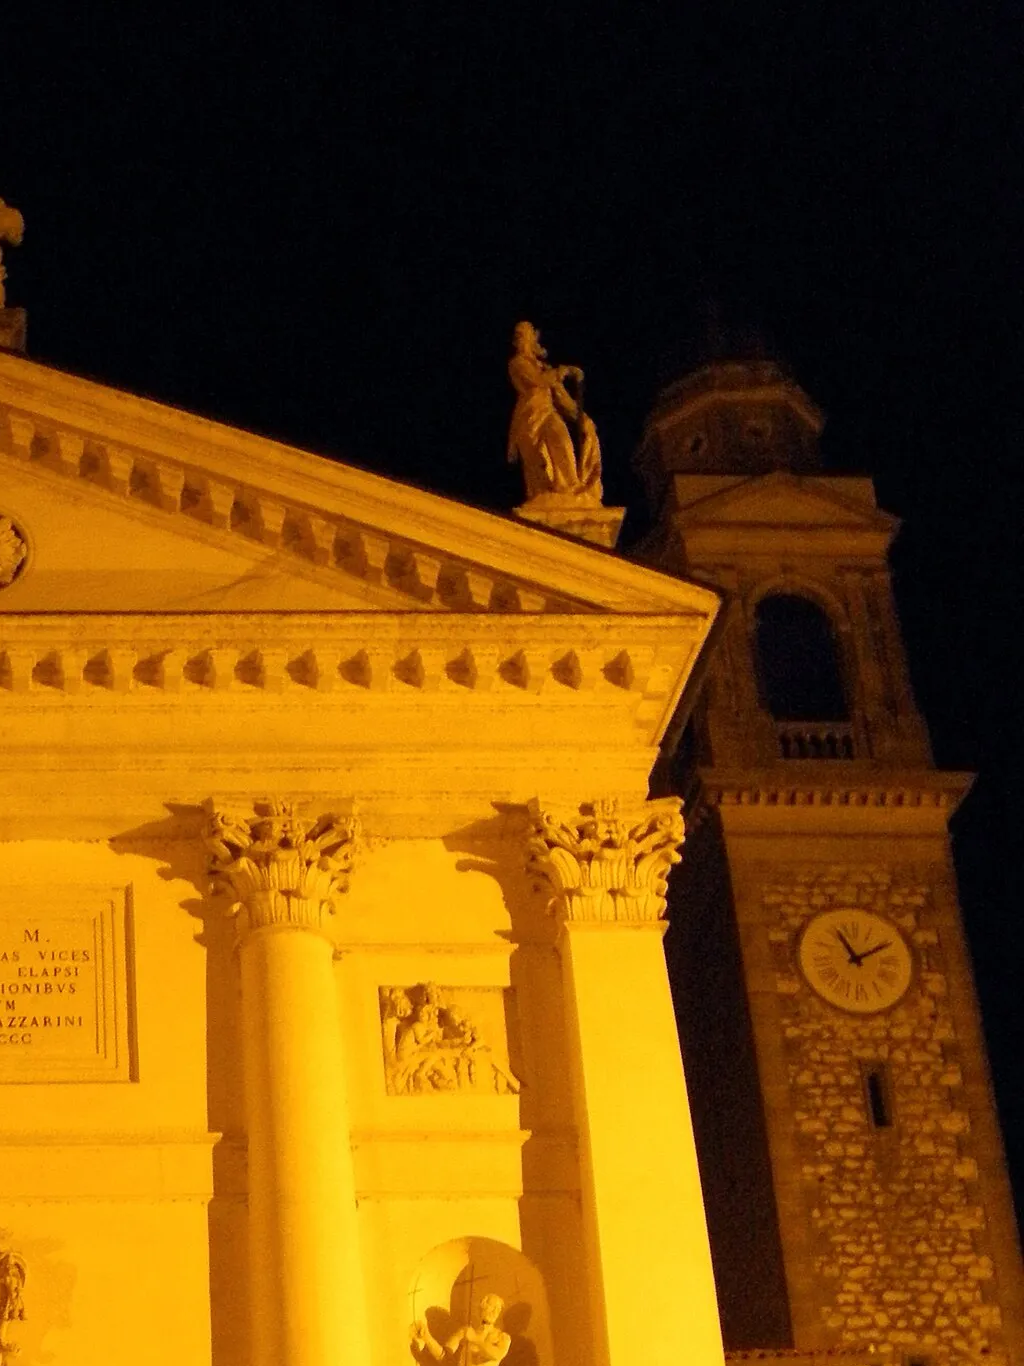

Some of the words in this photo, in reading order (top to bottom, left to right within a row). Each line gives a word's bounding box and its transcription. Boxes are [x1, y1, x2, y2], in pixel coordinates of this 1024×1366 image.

[23, 927, 51, 944] M.
[37, 949, 92, 963] VICES
[17, 965, 80, 979] ELAPSI
